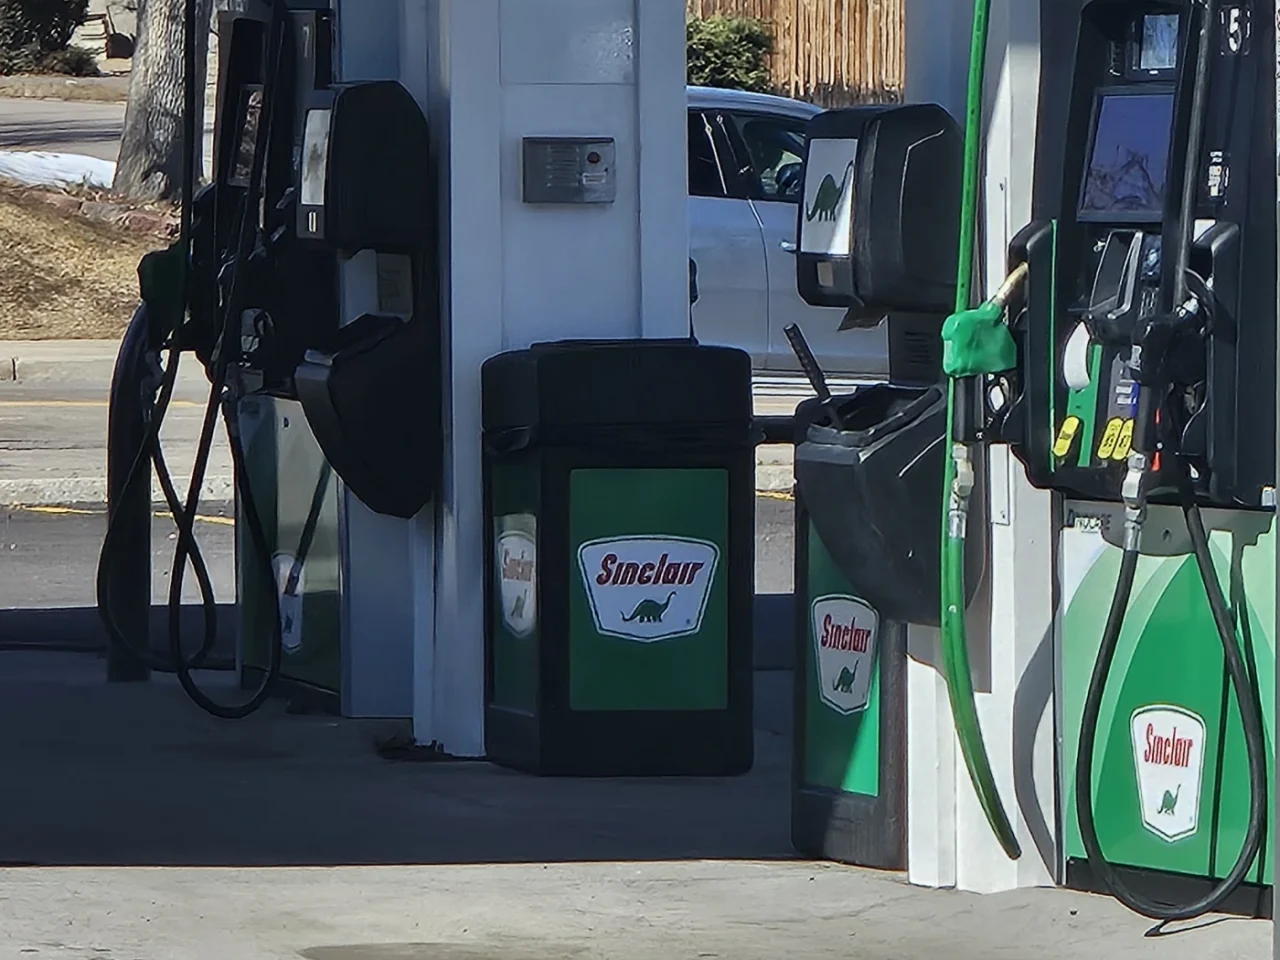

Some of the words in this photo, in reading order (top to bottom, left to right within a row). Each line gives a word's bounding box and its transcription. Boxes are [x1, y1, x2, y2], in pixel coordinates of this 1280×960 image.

[596, 553, 705, 586] Sinclair
[821, 613, 872, 653] Sinclair
[1144, 722, 1194, 768] Sinclair
